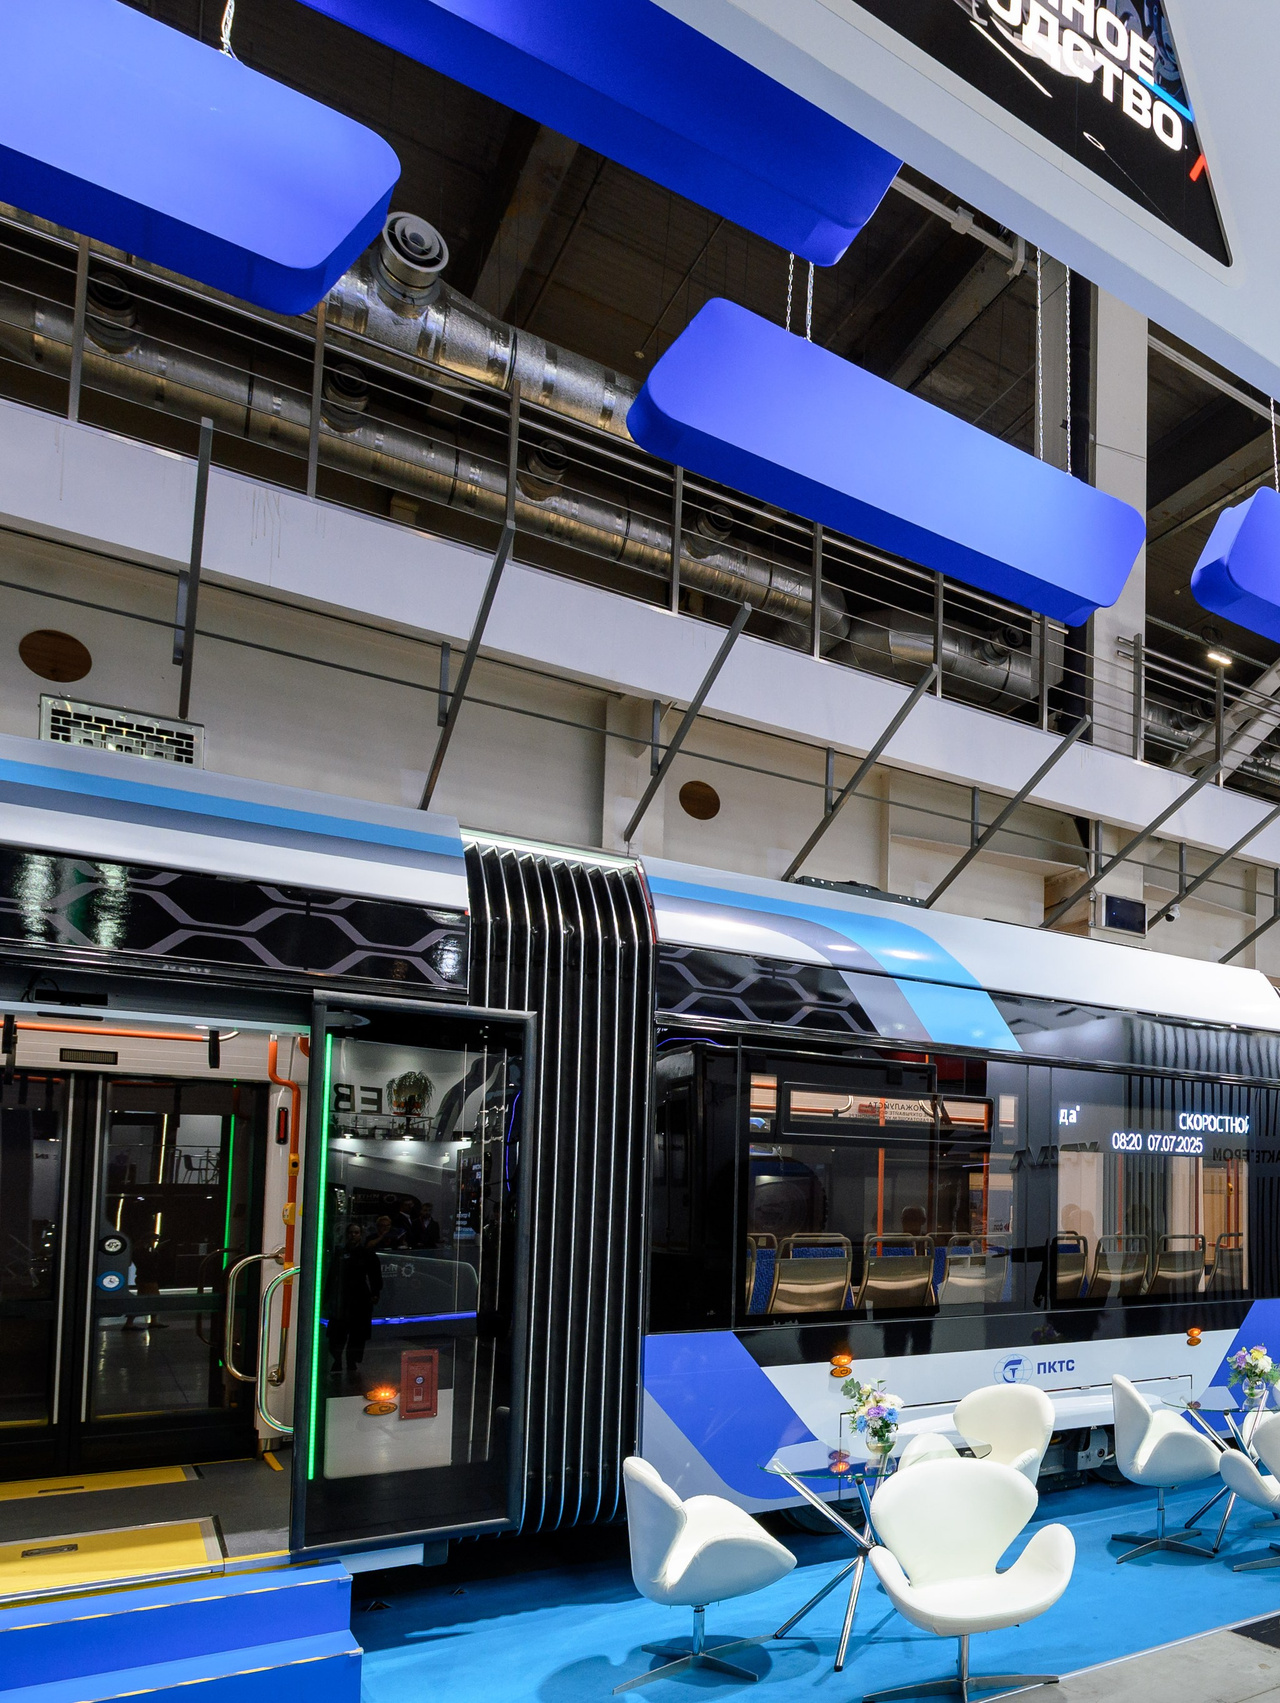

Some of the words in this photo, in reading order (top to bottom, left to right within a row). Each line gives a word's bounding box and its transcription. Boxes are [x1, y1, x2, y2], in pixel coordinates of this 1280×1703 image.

[1112, 1132, 1142, 1151] 08:20
[1147, 1134, 1204, 1154] 07.07.2025
[1037, 1359, 1075, 1375] ПКТС
